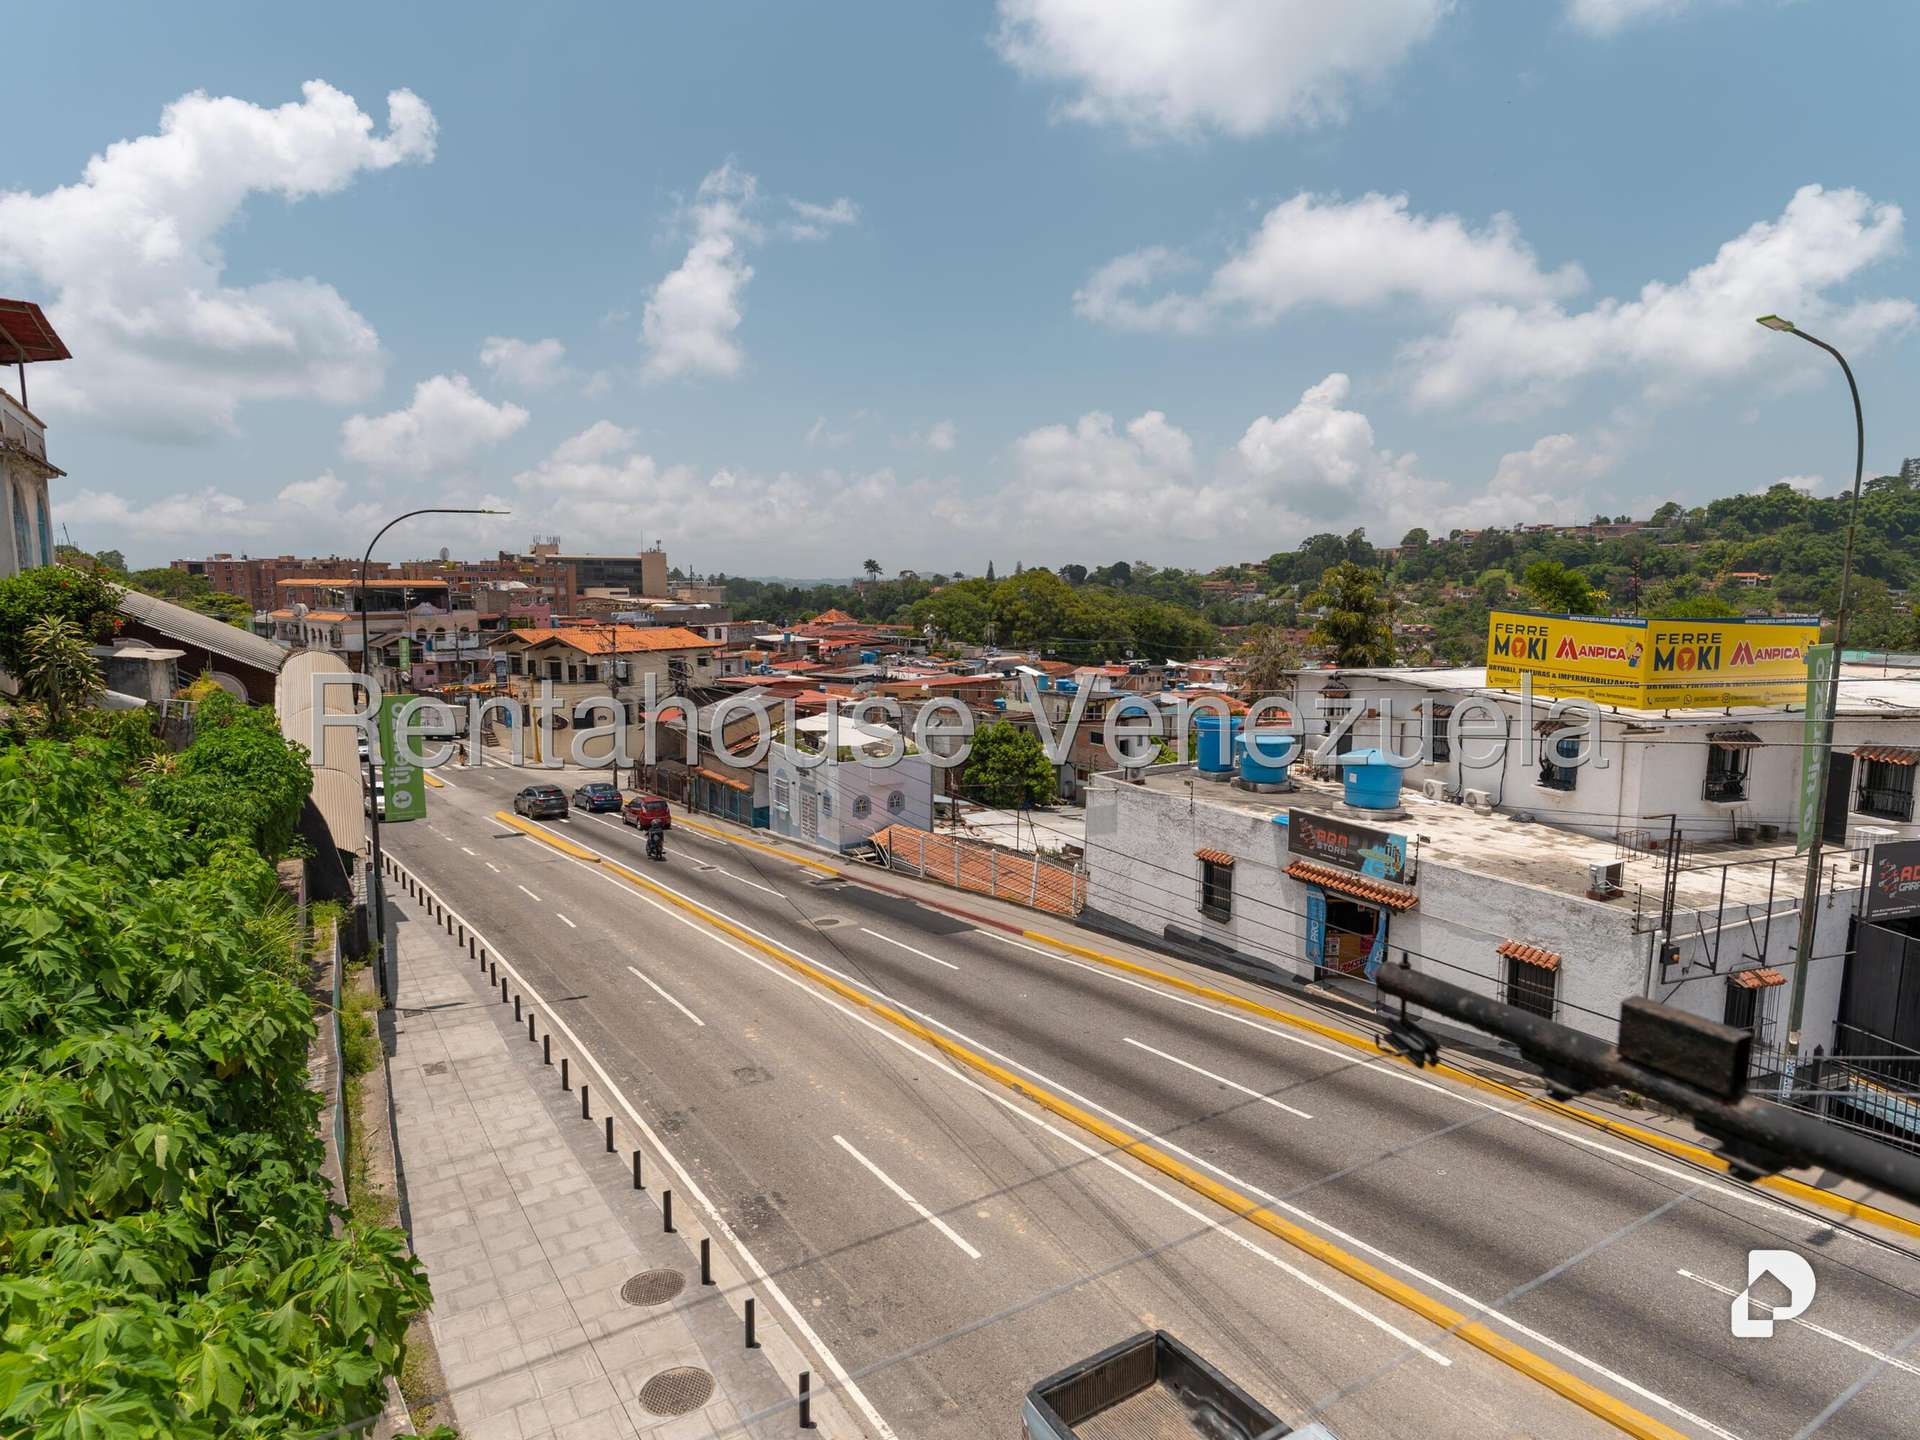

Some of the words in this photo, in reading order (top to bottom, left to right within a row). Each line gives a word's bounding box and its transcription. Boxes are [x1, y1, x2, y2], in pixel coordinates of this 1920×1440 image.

[1495, 623, 1549, 637] FERRE
[1655, 633, 1722, 645] FERRE
[1493, 634, 1548, 661] MOKI
[1554, 635, 1627, 661] MANPICA
[1653, 646, 1721, 672] MOKI
[1729, 640, 1801, 667] MANPICA
[1807, 657, 1826, 794] tijerazo
[1316, 842, 1347, 857] STORE
